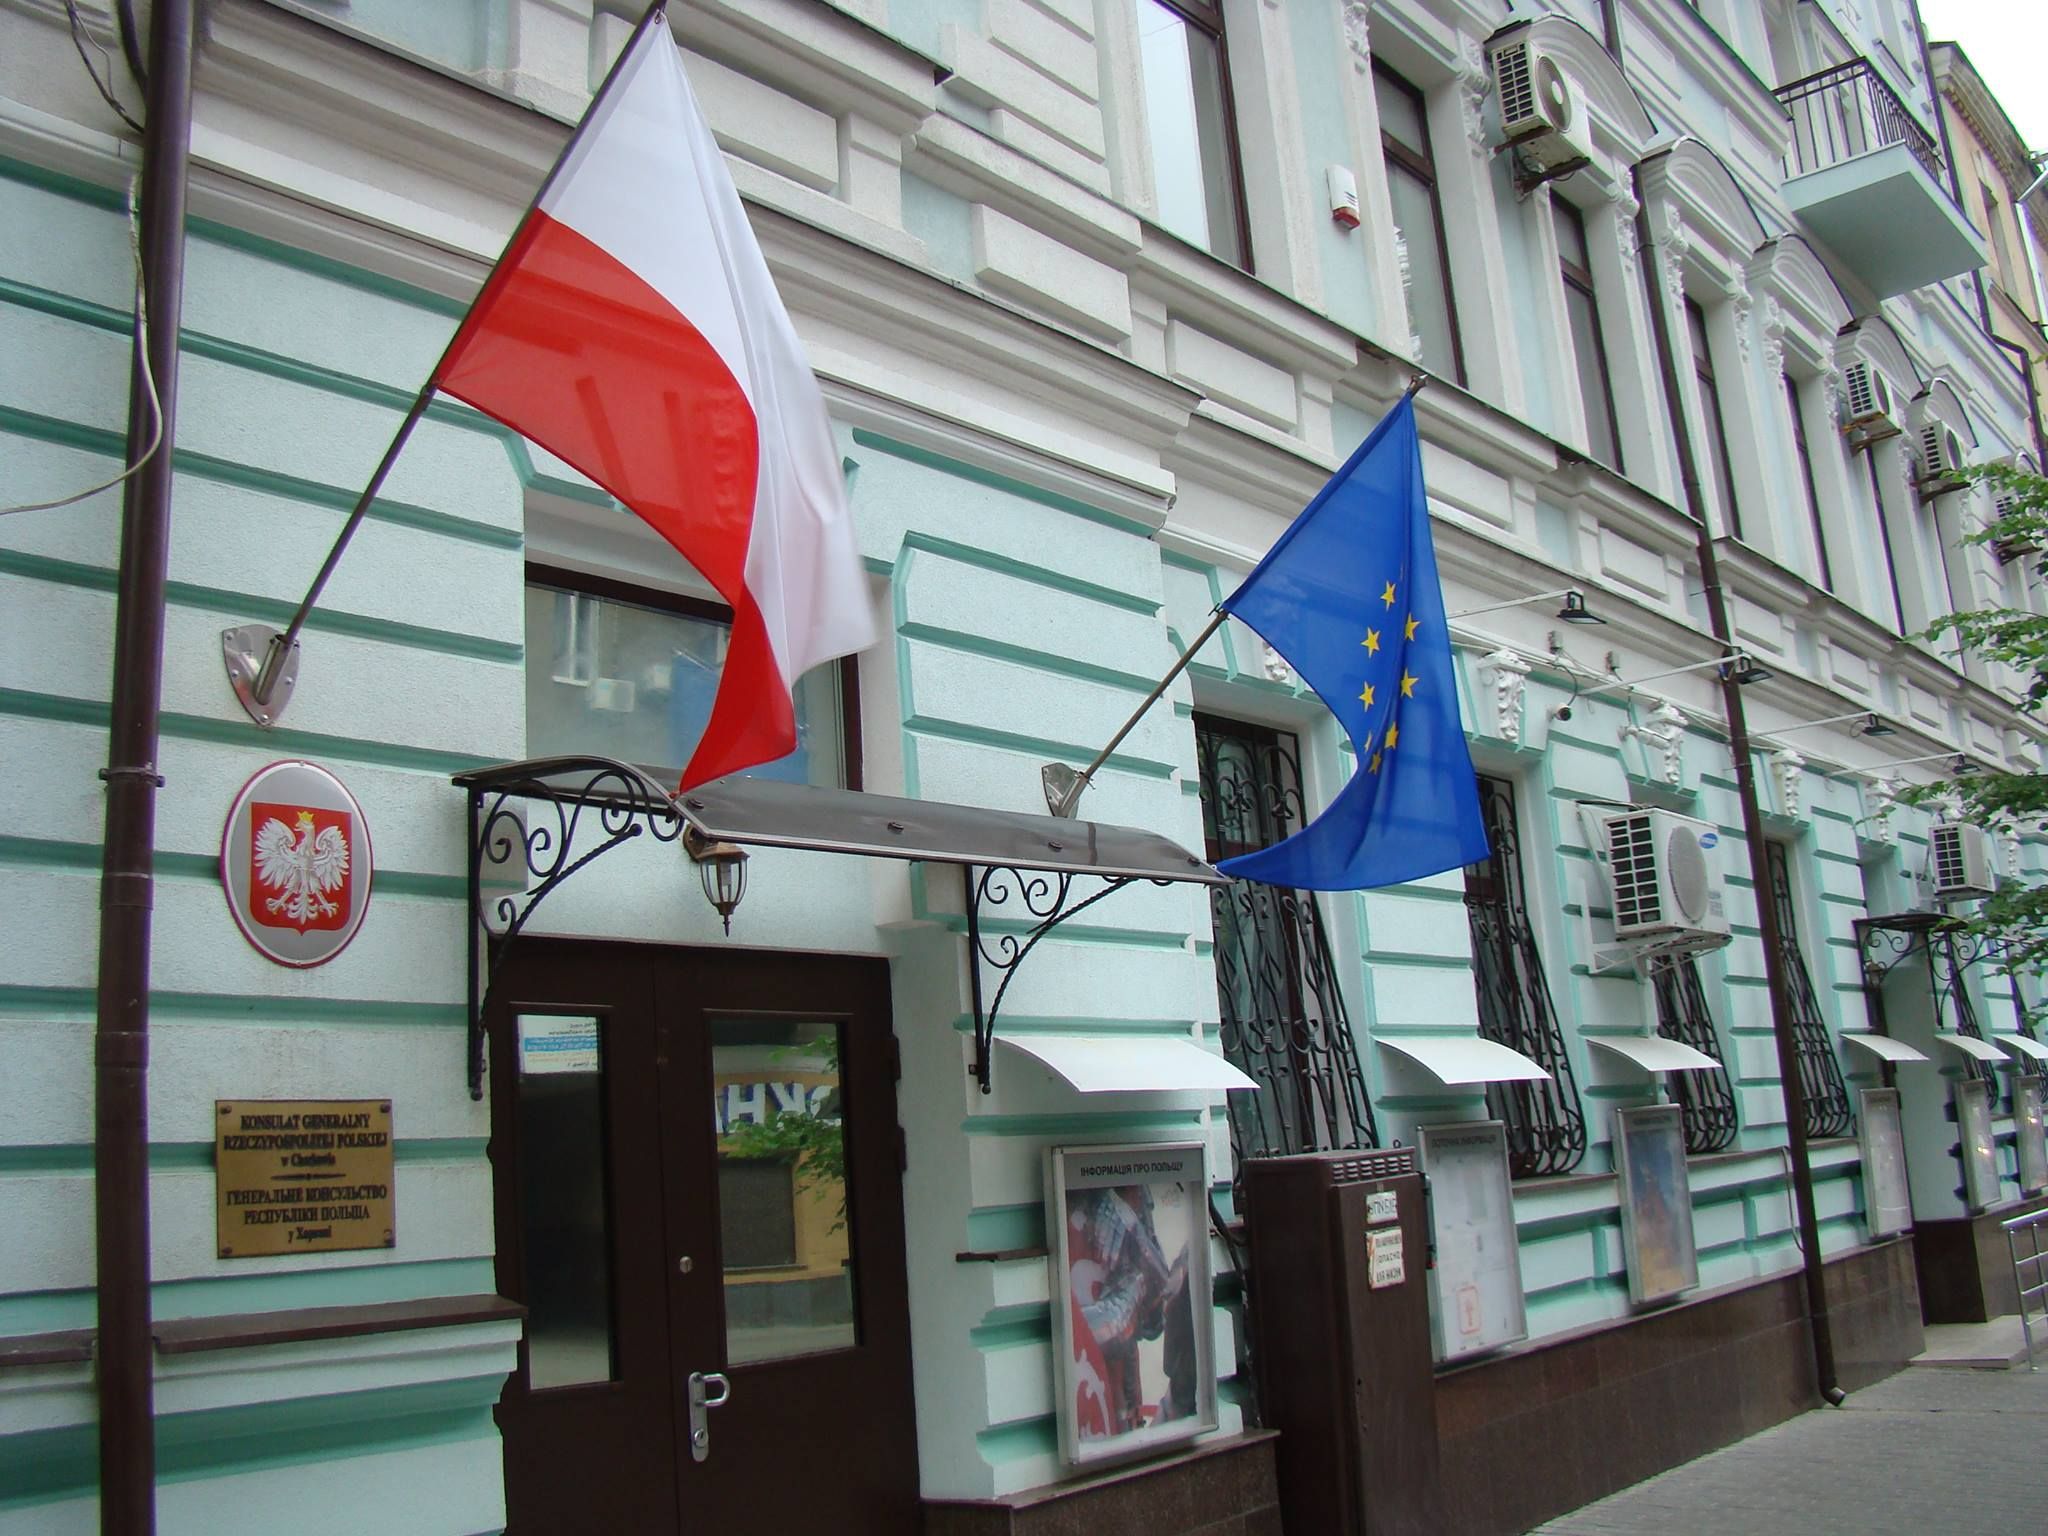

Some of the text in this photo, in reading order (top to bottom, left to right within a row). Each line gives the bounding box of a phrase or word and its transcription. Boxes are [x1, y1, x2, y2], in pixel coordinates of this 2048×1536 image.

[241, 1114, 370, 1130] KONSULAT GENERALNY
[224, 1133, 388, 1150] RZECZYPOSPOLITEJ POLSKIEJ
[1081, 1164, 1132, 1176] ІНФОРМАЦІЯ
[1133, 1163, 1150, 1174] ПРО
[226, 1185, 387, 1206] ГЕНЕРАЛЬНЕ КОНСУЛЬСТВО
[244, 1205, 370, 1225] РЕСПУБЛІКИ ПОЛЬЩА
